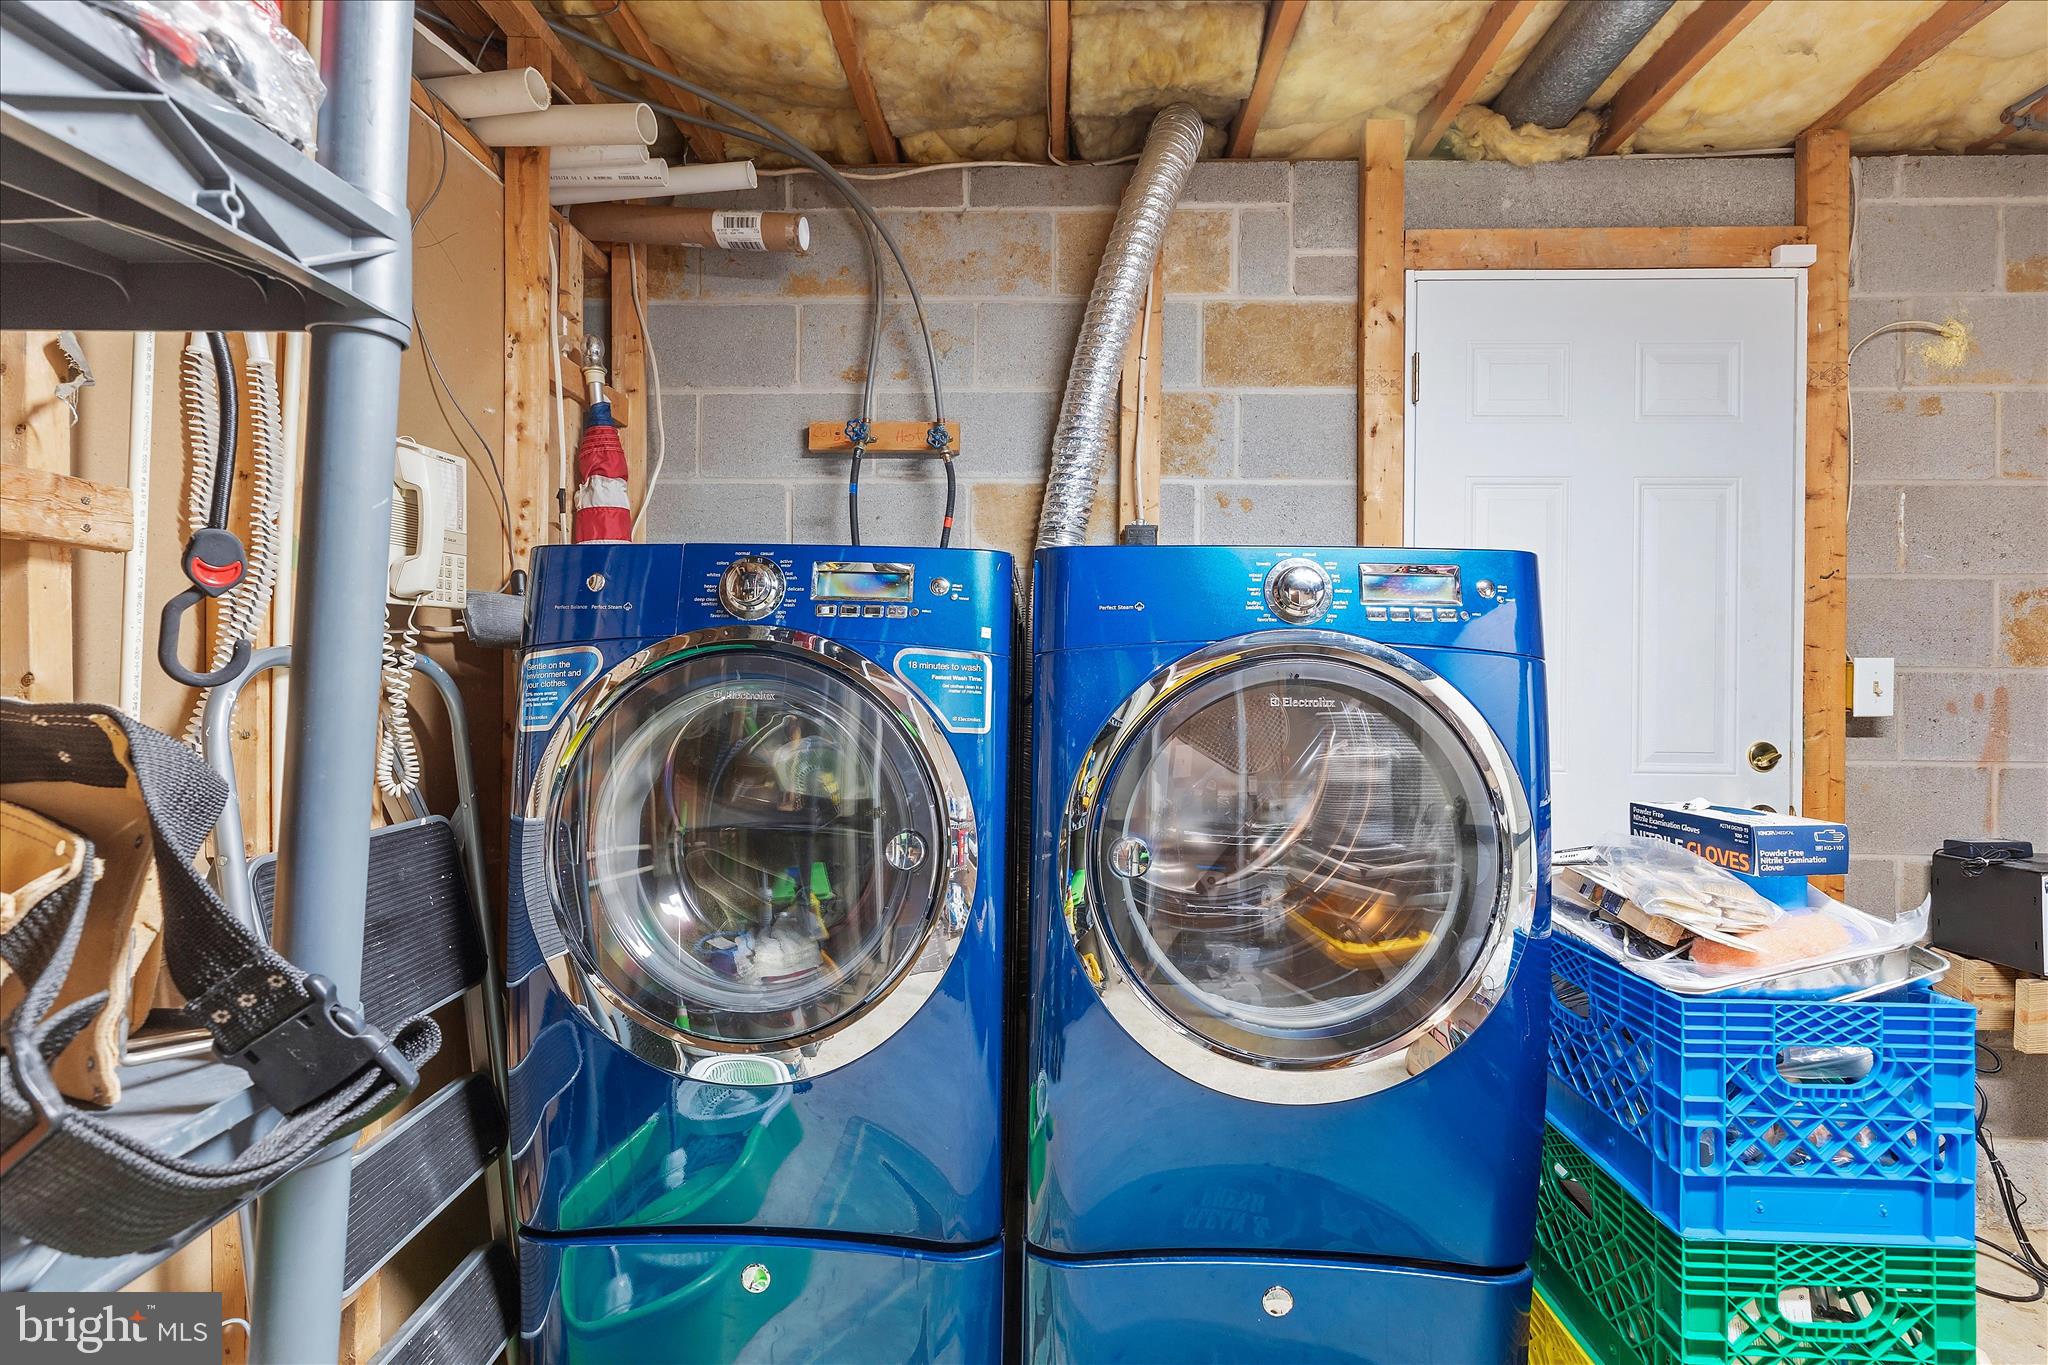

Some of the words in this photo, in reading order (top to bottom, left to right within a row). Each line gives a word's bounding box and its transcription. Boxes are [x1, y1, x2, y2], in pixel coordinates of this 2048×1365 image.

[527, 662, 546, 671] Gentle
[908, 661, 917, 669] 18
[919, 662, 950, 670] minutes
[951, 663, 960, 671] to
[960, 664, 983, 672] wash.
[527, 671, 567, 679] environment
[567, 669, 582, 677] and
[526, 681, 539, 690] your
[540, 679, 568, 688] clothes.
[1282, 696, 1336, 708] Electrolux
[1632, 806, 1652, 816] Powder
[1652, 811, 1664, 819] Free
[1632, 814, 1648, 823] Nitrile
[1649, 817, 1681, 830] Examination
[1681, 823, 1701, 835] Gloves
[1686, 841, 1750, 872] GLOVES
